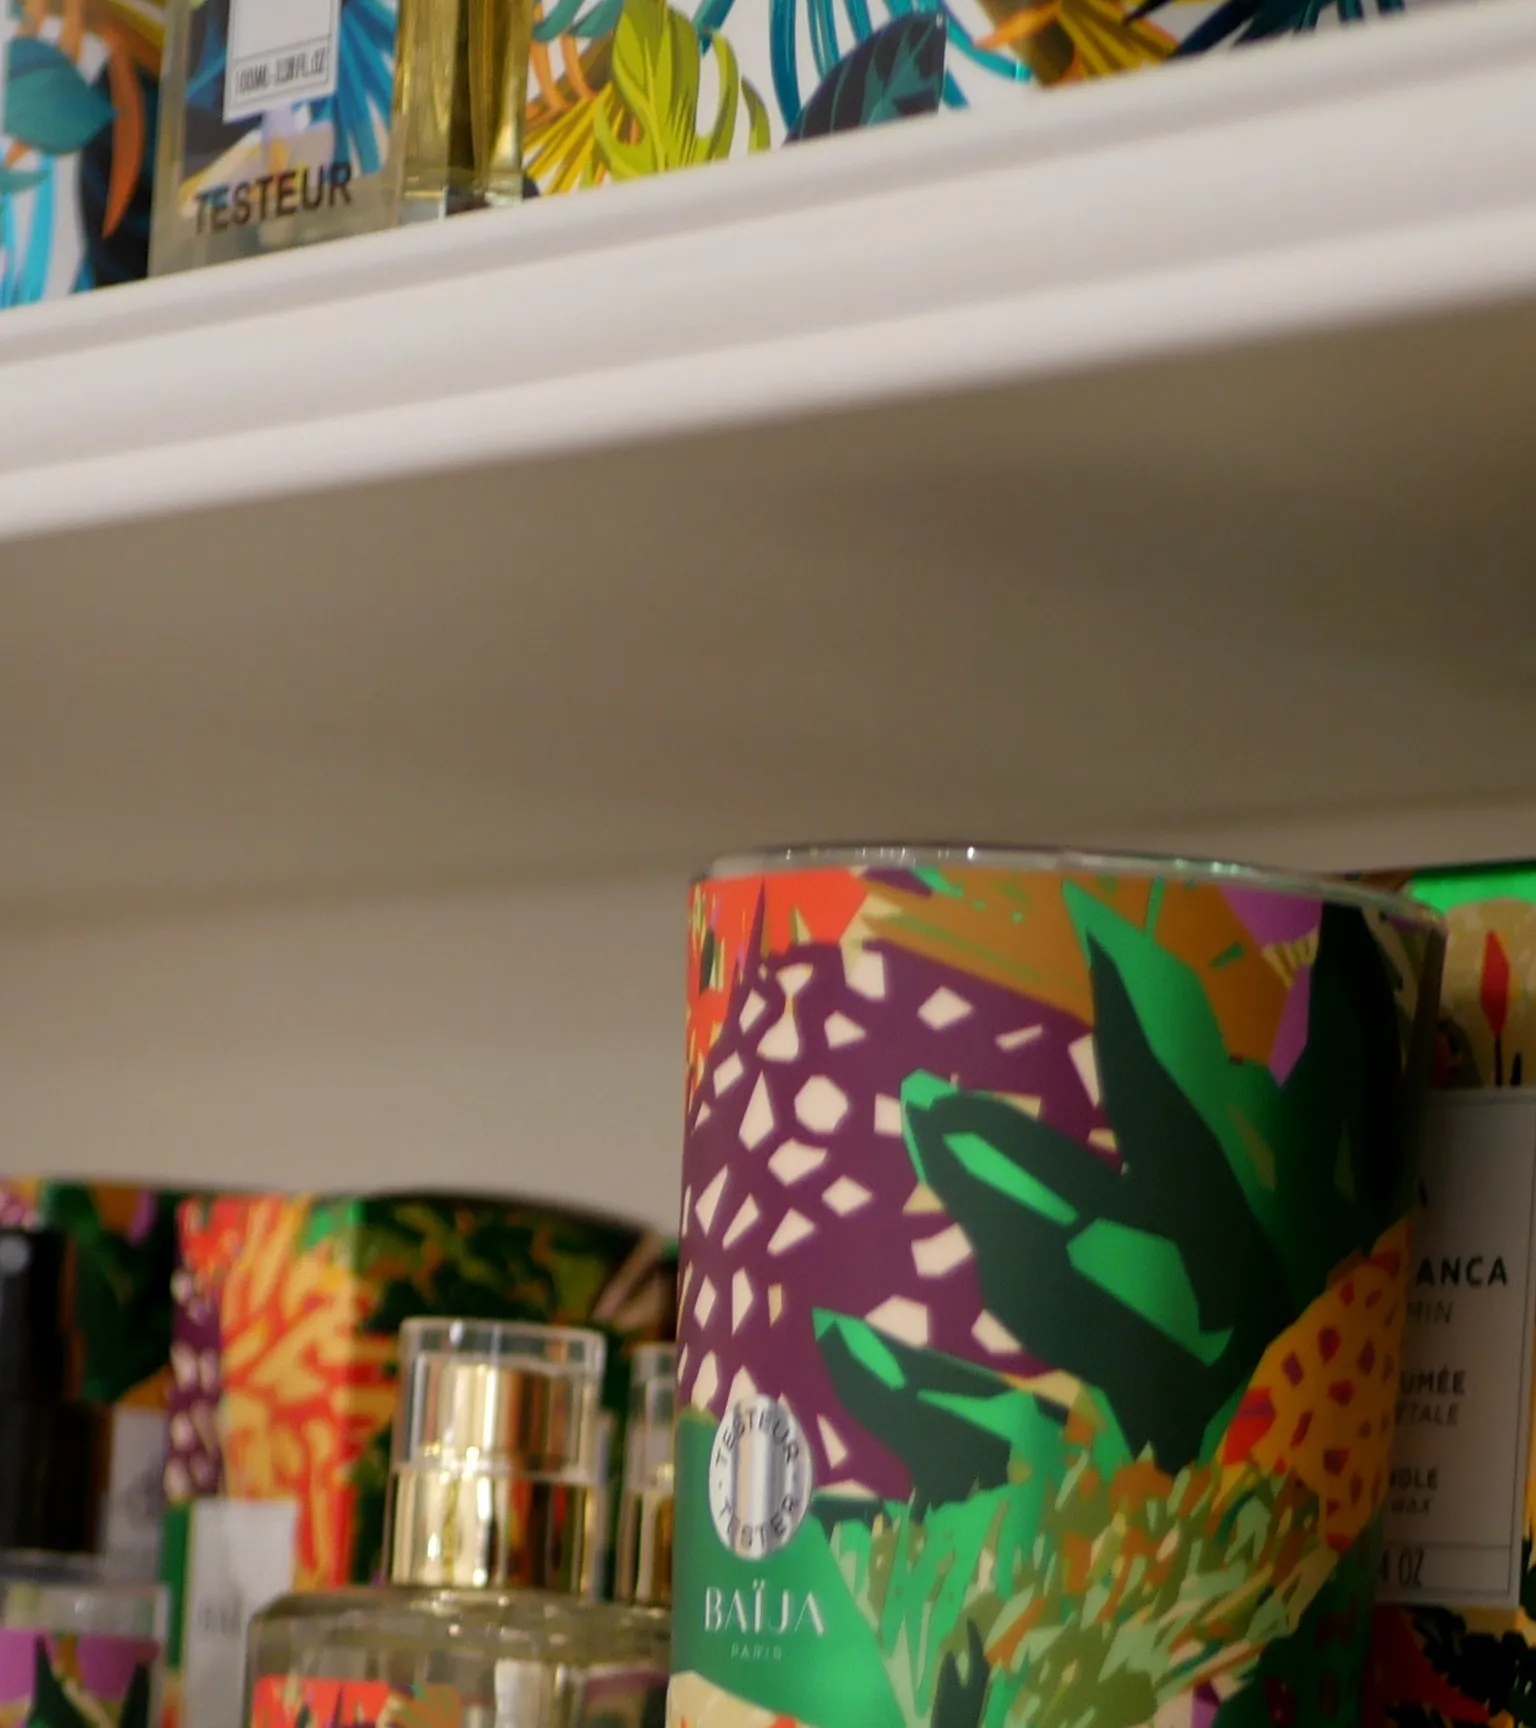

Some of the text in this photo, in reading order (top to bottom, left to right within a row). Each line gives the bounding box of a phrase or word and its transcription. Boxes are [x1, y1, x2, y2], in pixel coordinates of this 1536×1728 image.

[195, 162, 352, 234] TESTEUR
[715, 1406, 800, 1469] TESTEUR
[703, 1578, 826, 1637] BAÏJA
